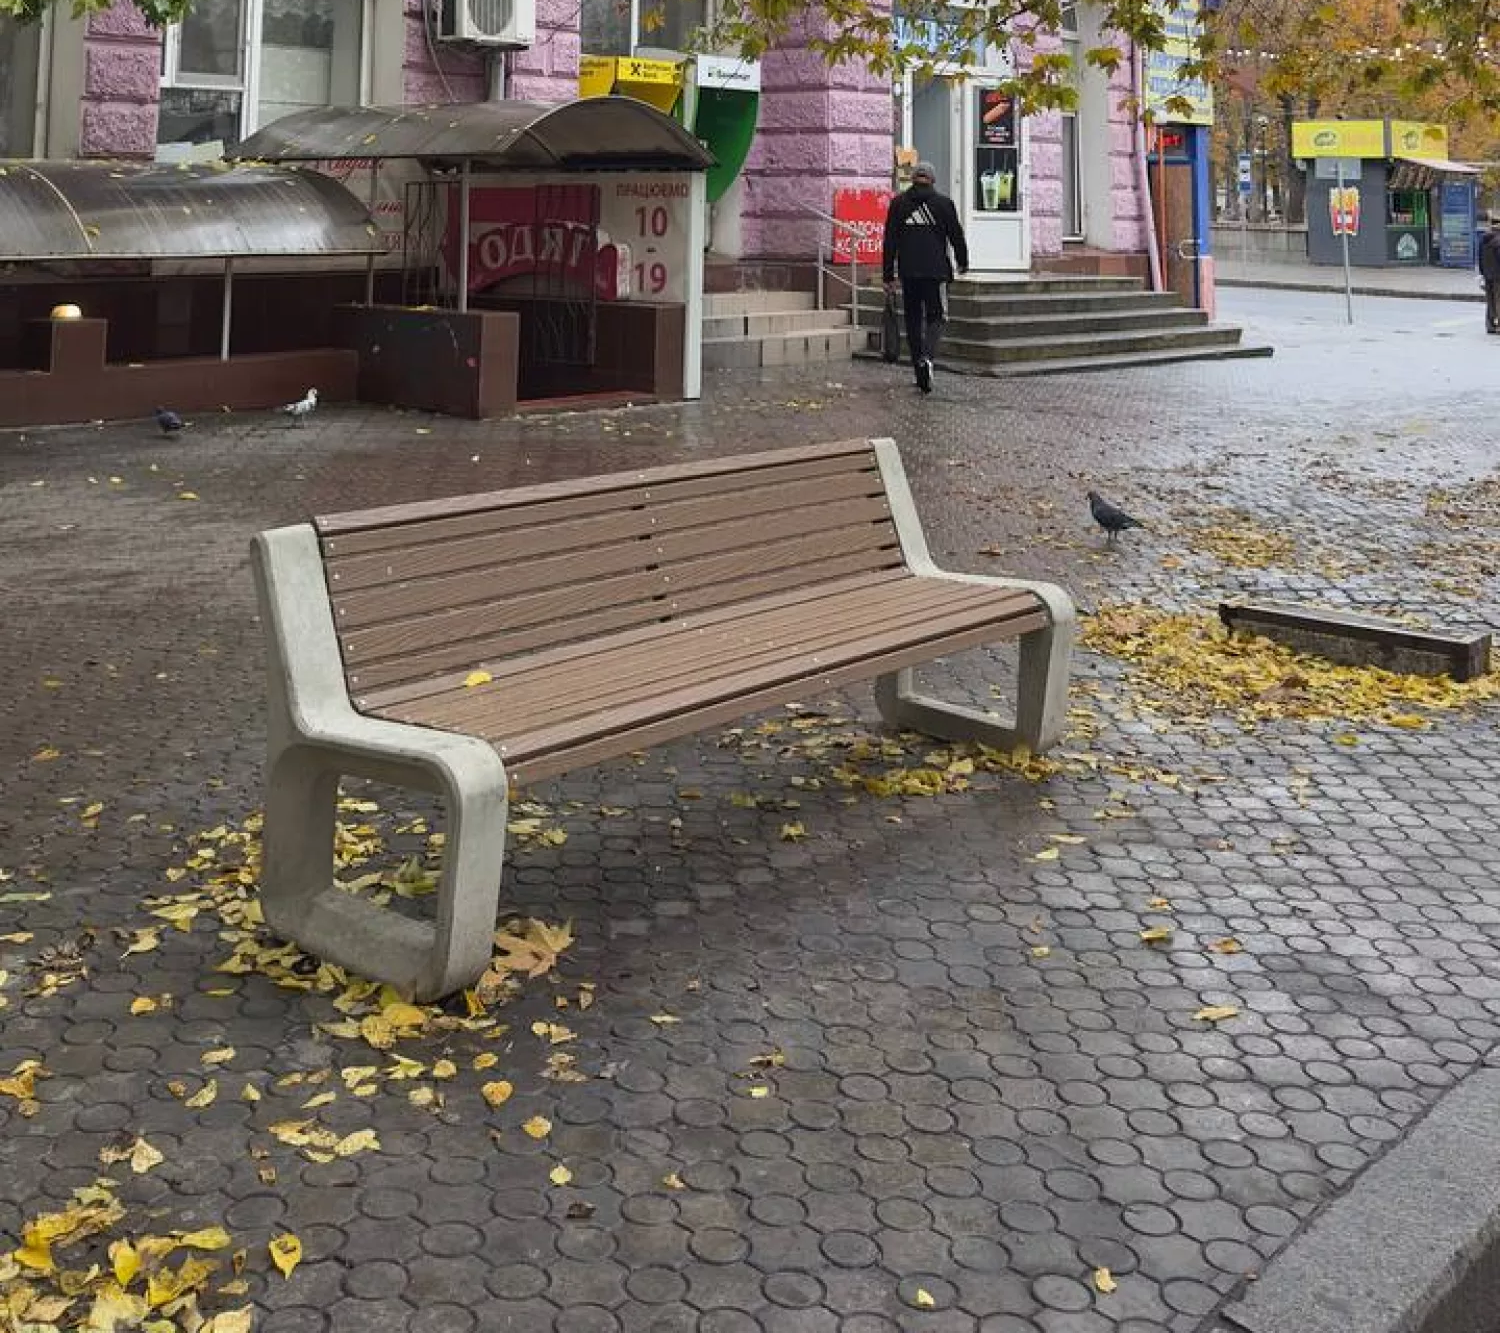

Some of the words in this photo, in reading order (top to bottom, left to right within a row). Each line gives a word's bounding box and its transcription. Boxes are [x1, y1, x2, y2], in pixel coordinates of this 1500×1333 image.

[635, 206, 667, 237] 10
[480, 225, 591, 269] ОДЯГ
[836, 237, 884, 253] КОКТЕЙ
[635, 262, 667, 294] 19
